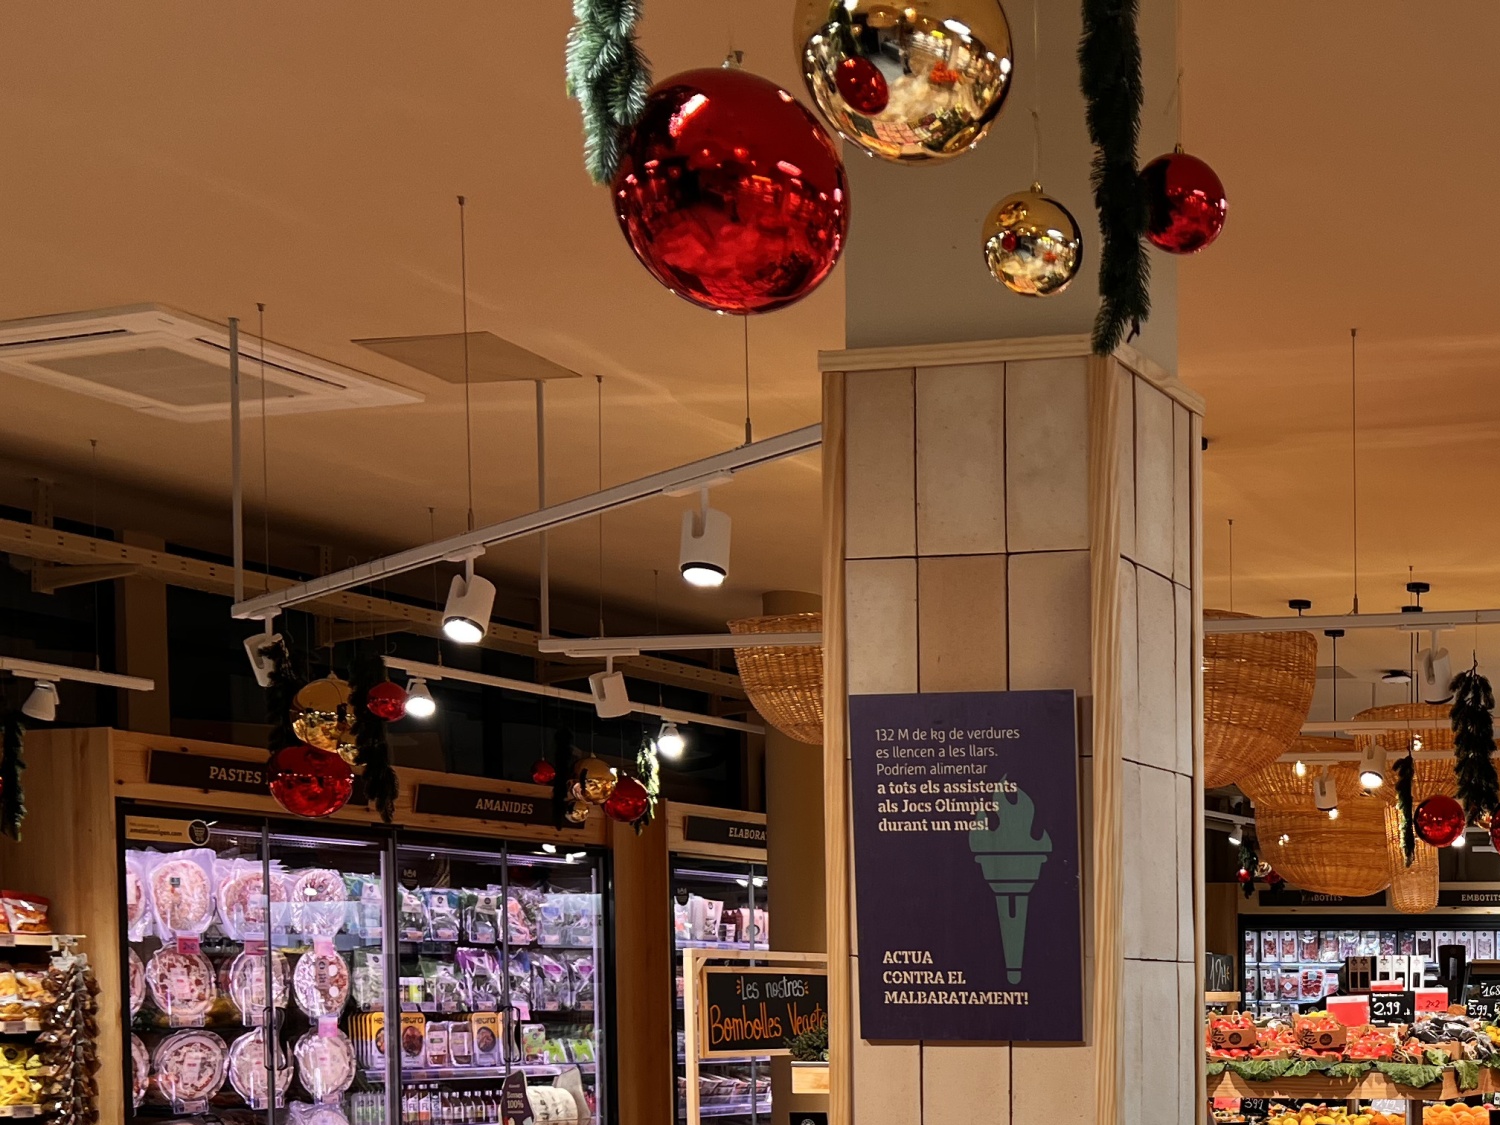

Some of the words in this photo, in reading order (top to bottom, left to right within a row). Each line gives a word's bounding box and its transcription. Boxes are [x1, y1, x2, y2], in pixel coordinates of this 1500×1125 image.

[875, 729, 894, 741] 132
[898, 729, 909, 741] M
[912, 729, 927, 740] de
[931, 728, 946, 744] kg
[949, 728, 964, 740] de
[967, 728, 1019, 739] verdures
[876, 748, 889, 758] es
[892, 746, 934, 758] llencen
[938, 748, 946, 757] a
[949, 745, 966, 757] les
[969, 745, 998, 757] llars.
[209, 766, 262, 784] PASTES
[877, 763, 926, 776] Podríem
[930, 762, 988, 775] alimentar
[878, 784, 886, 794] a
[889, 781, 917, 794] tots
[920, 781, 940, 793] els
[944, 780, 1017, 793] assistents
[475, 797, 534, 815] AMANIDES
[878, 800, 898, 813] als
[902, 799, 932, 813] Jocs
[935, 798, 999, 815] Olímpics
[878, 818, 928, 832] durant
[932, 820, 951, 831] un
[954, 818, 989, 831] mes!
[728, 826, 767, 841] ELABORA
[883, 950, 933, 964] ACTUA
[883, 971, 944, 984] CONTRA
[948, 971, 966, 984] EL
[740, 976, 760, 1000] Les
[765, 976, 806, 999] nostres
[884, 991, 1028, 1005] MALBARATAMENT!
[709, 1002, 783, 1045] Bombolles
